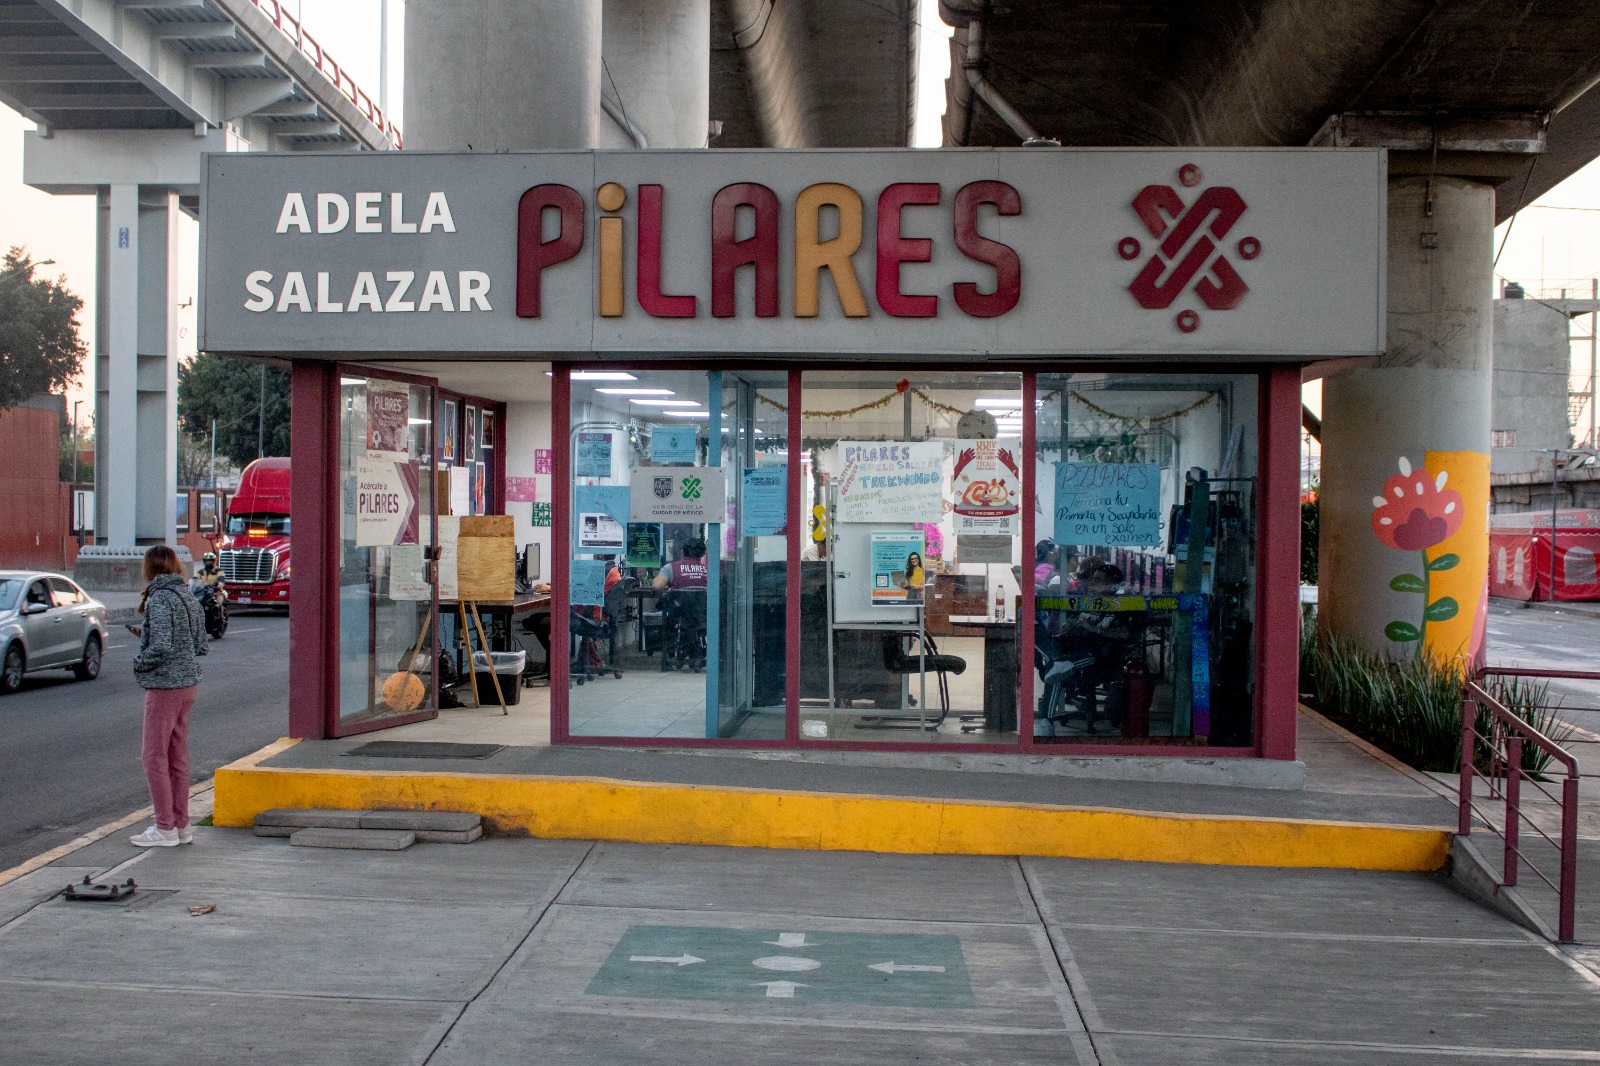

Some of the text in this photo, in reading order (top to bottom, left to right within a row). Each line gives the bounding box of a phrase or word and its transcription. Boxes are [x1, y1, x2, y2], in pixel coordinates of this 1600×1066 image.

[275, 192, 456, 233] ADELA
[244, 271, 493, 313] SALAZAR
[1059, 464, 1148, 490] PILARES
[1115, 490, 1128, 506] tu
[1056, 507, 1096, 521] Primaria
[1099, 512, 1105, 522] y
[1075, 524, 1088, 535] en
[1092, 523, 1107, 534] un
[1105, 533, 1153, 544] examen
